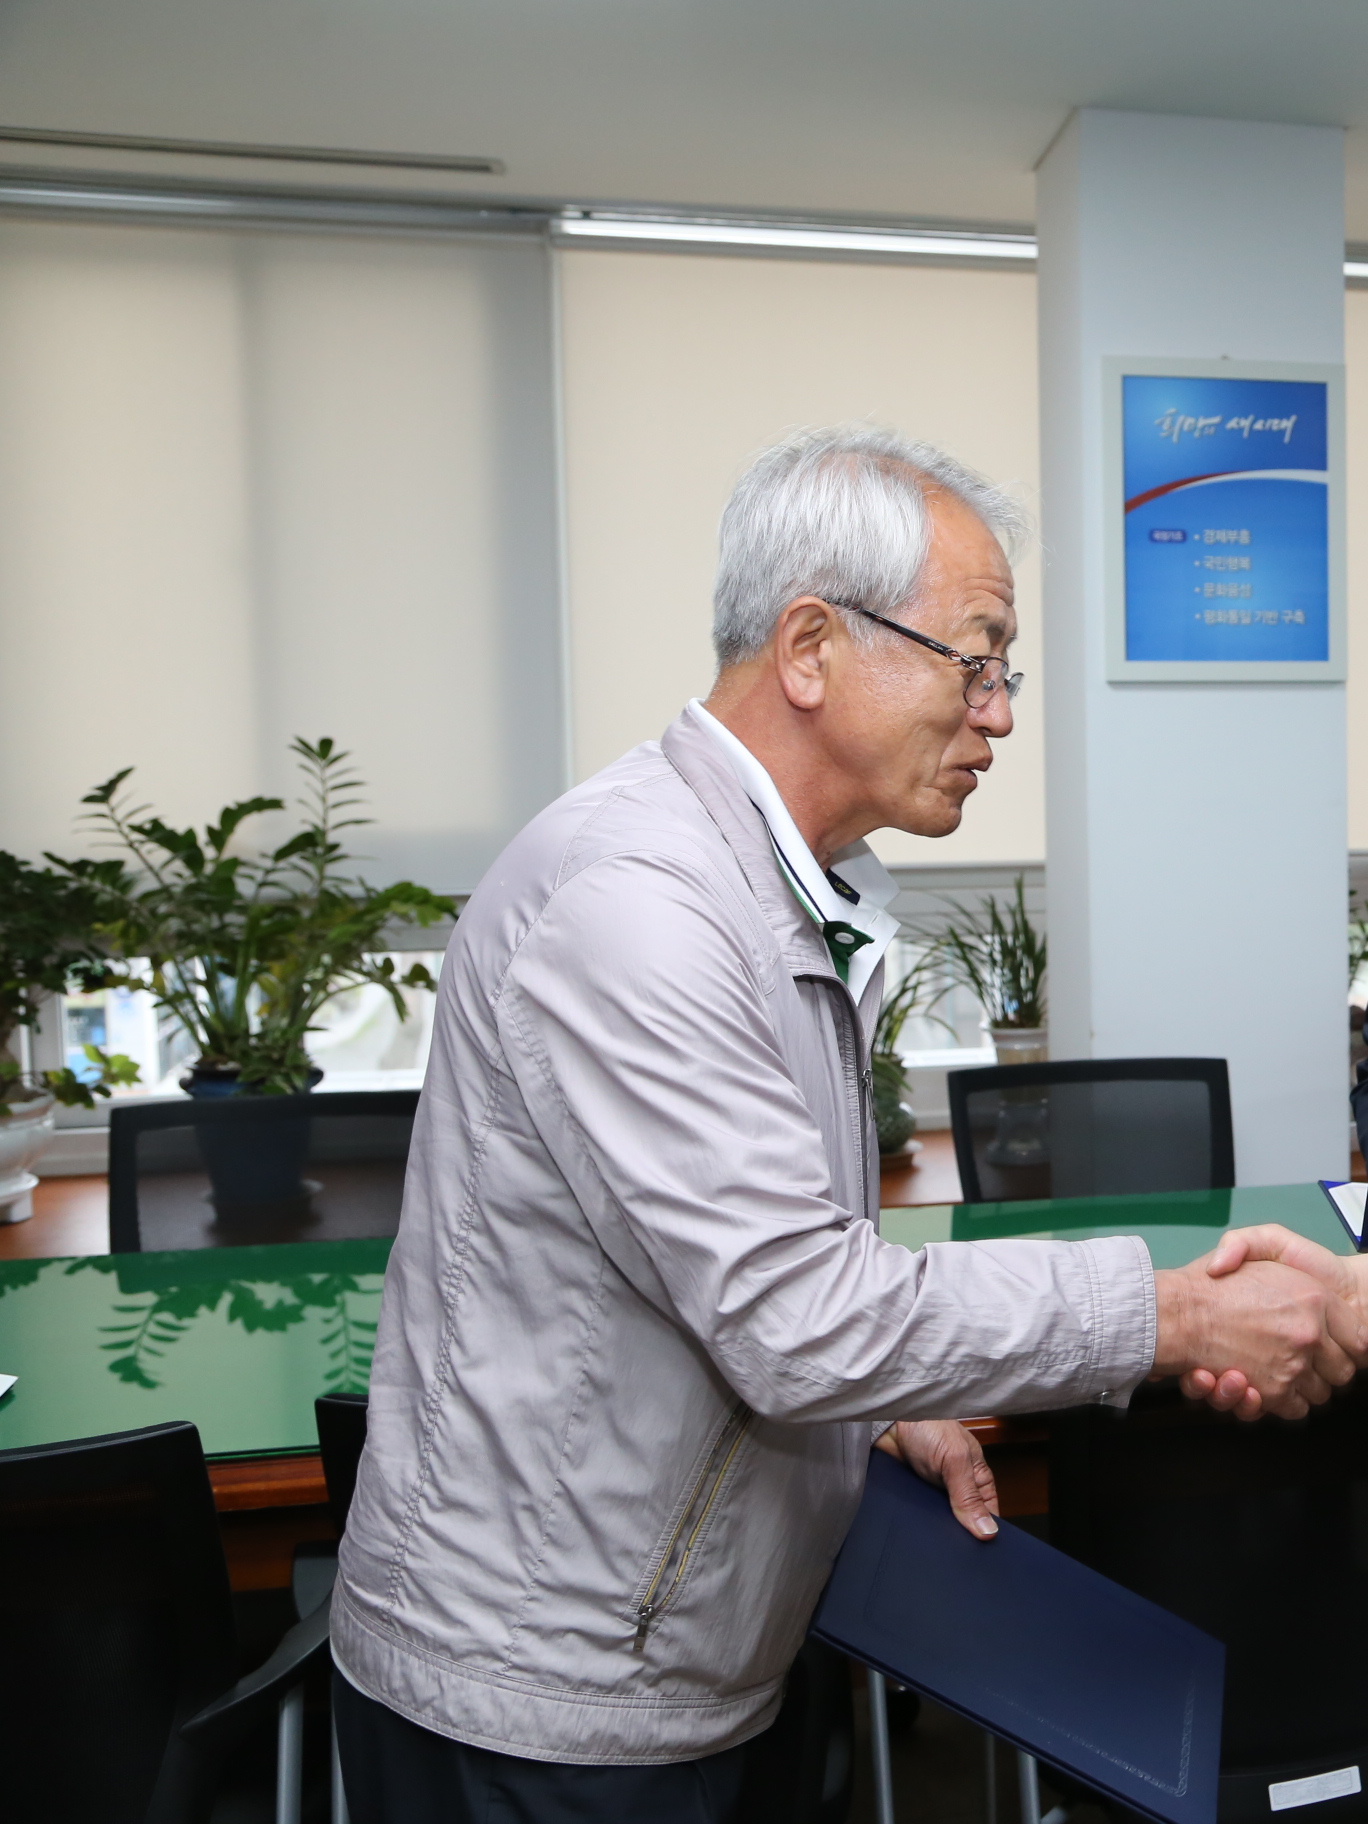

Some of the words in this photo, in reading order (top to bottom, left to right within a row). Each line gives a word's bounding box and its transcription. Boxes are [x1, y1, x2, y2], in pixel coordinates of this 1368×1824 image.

[1154, 407, 1222, 444] 희망의
[1203, 529, 1251, 546] 경제부흥
[1203, 555, 1251, 571] 국민행복
[1203, 582, 1252, 599] 문화융성
[1204, 609, 1252, 626] 평화통일
[1254, 610, 1279, 626] 기반
[1281, 609, 1306, 625] 구축
